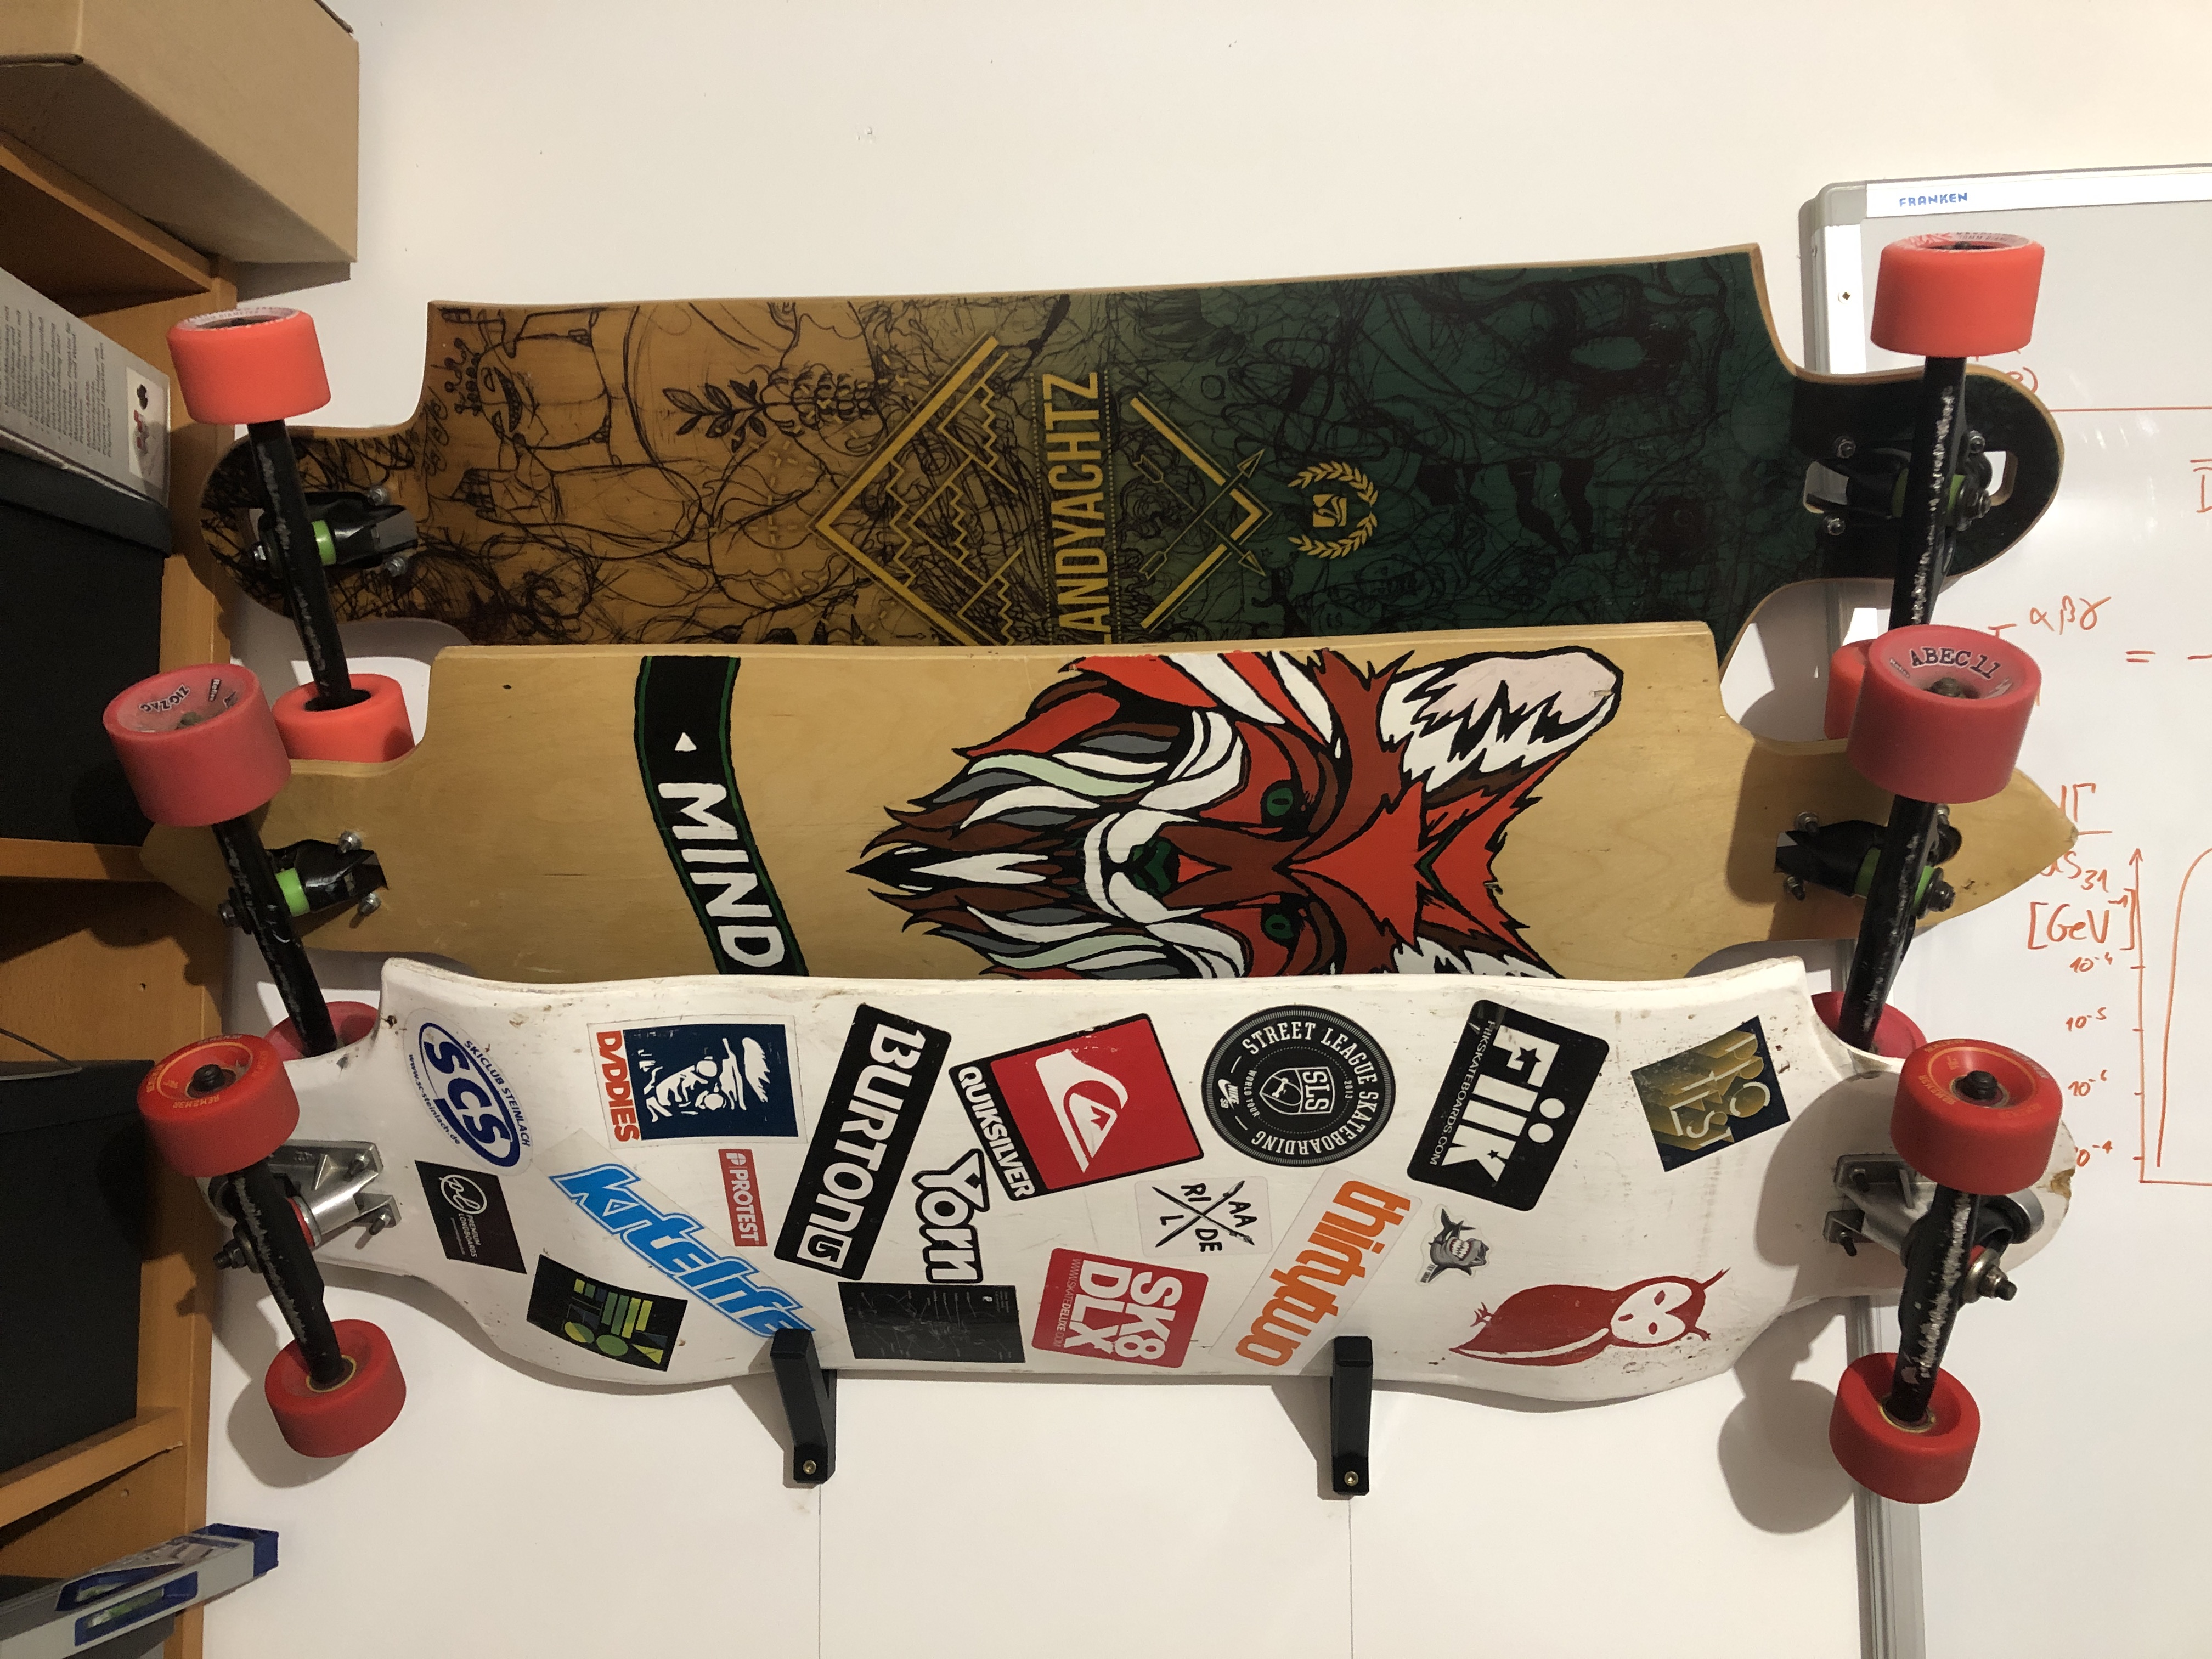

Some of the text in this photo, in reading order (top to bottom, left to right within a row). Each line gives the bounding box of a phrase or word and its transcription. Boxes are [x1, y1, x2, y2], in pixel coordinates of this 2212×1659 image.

[1898, 191, 1968, 207] FRANKEN
[1909, 647, 2002, 680] ABEC 11
[658, 782, 786, 967] MIND
[423, 1041, 511, 1144] SCS
[464, 1040, 531, 1147] SKICLUB STEINLACH
[596, 1030, 640, 1142] DADDIES
[808, 1023, 927, 1233] BURTON
[1242, 1020, 1380, 1155] STREET LEAGUE SKATEBOARDING
[1243, 1069, 1261, 1118] WORLD TOUR
[1302, 1070, 1330, 1112] SLS
[958, 1066, 1036, 1199] QUIKSILVER
[458, 1213, 478, 1258] LONGBOARDS
[466, 1215, 482, 1246] PREMIUM
[729, 1169, 759, 1242] PROTEST
[1053, 1258, 1082, 1348] WWW.SKATEDELUXE.COM
[1063, 1259, 1133, 1356] DLX
[1114, 1271, 1183, 1361] SK8
